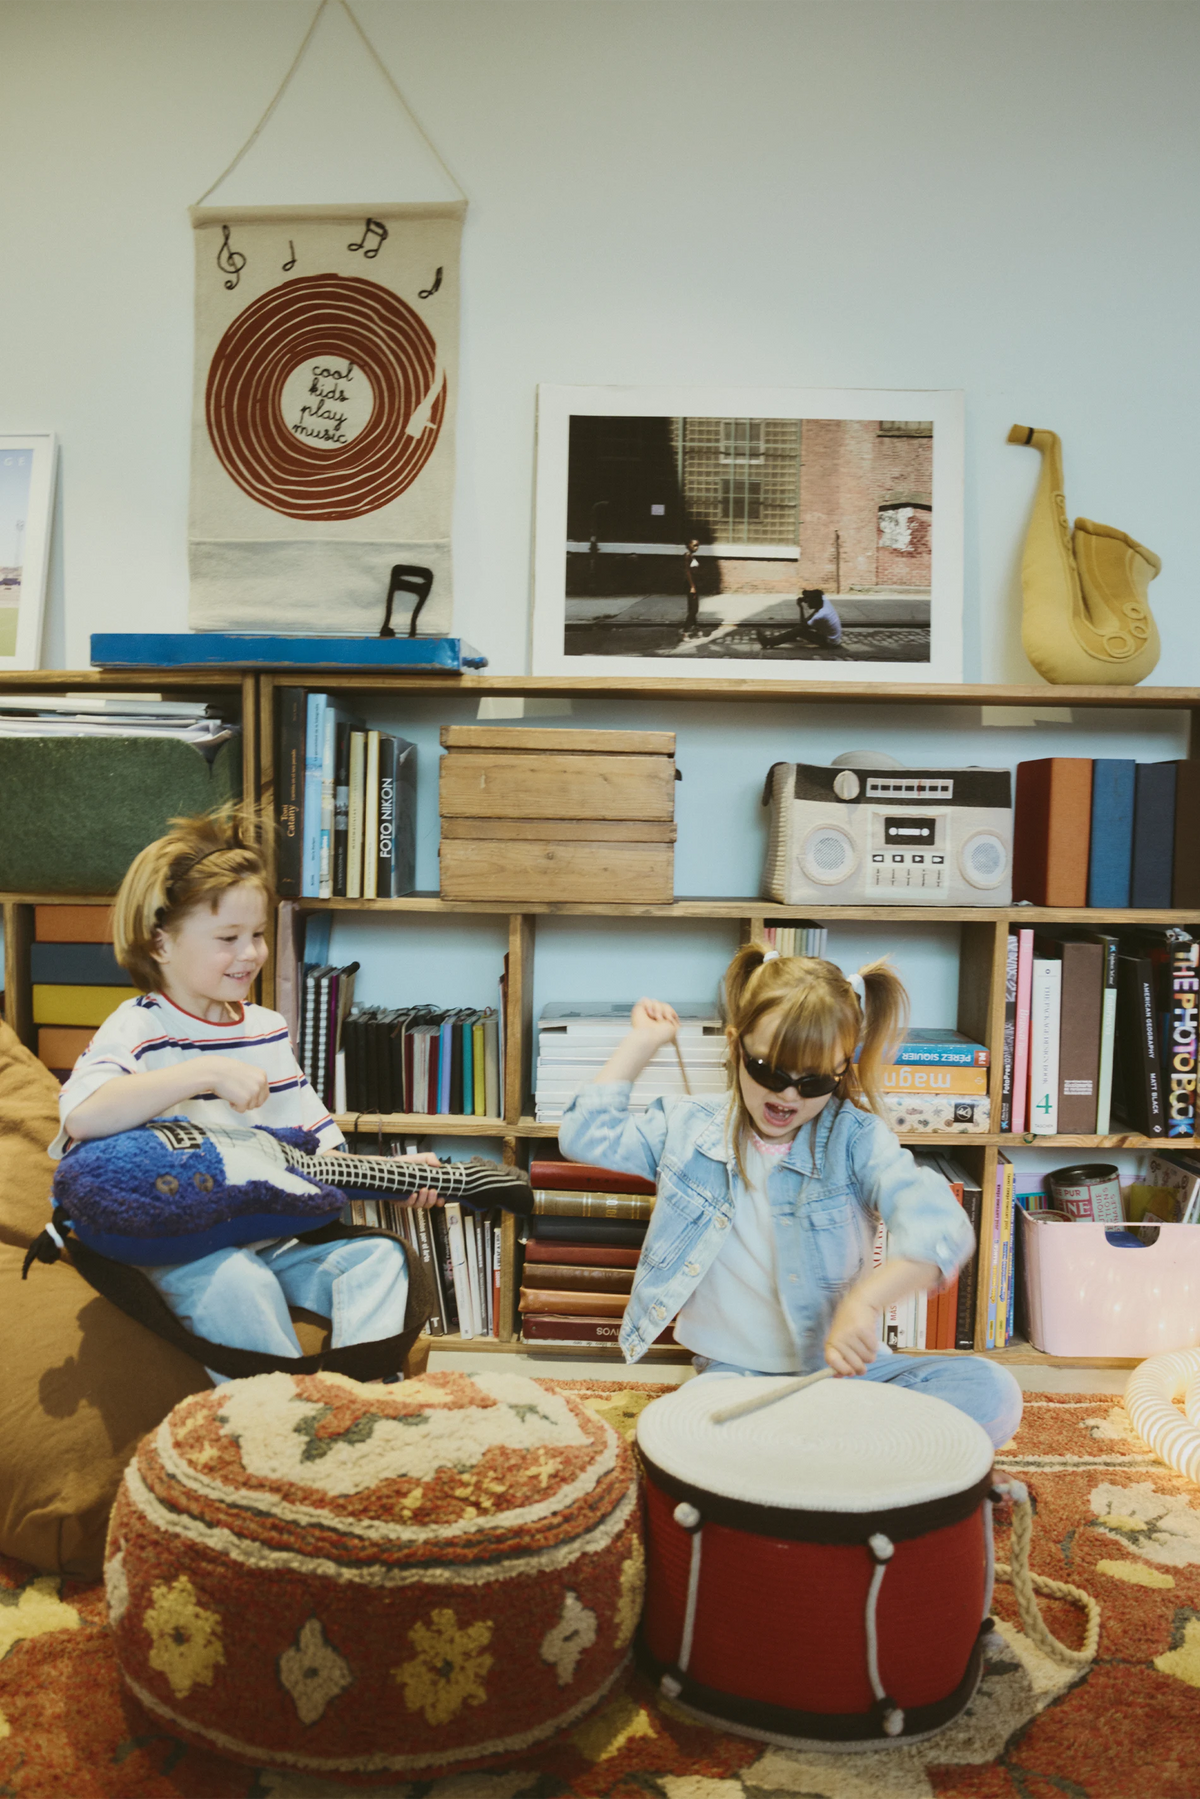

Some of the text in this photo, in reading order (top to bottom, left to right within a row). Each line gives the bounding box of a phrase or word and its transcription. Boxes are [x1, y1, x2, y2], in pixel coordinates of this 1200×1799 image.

[312, 362, 353, 382] cool
[308, 378, 350, 402] kids
[300, 399, 348, 431] play
[292, 423, 349, 444] music
[280, 804, 289, 821] Toni
[286, 804, 300, 837] Catany
[379, 778, 393, 858] FOTO NIKON
[1143, 982, 1155, 1059] AMERICAN GEOGRAPHY
[1041, 986, 1051, 1085] THE PACKAGE DESIGN BOOK
[901, 1052, 940, 1061] SIQUIER
[941, 1053, 972, 1064] PÉREZ
[1035, 1093, 1053, 1115] 4
[1149, 1072, 1160, 1114] MATT BLACK
[1063, 1189, 1081, 1197] PUR
